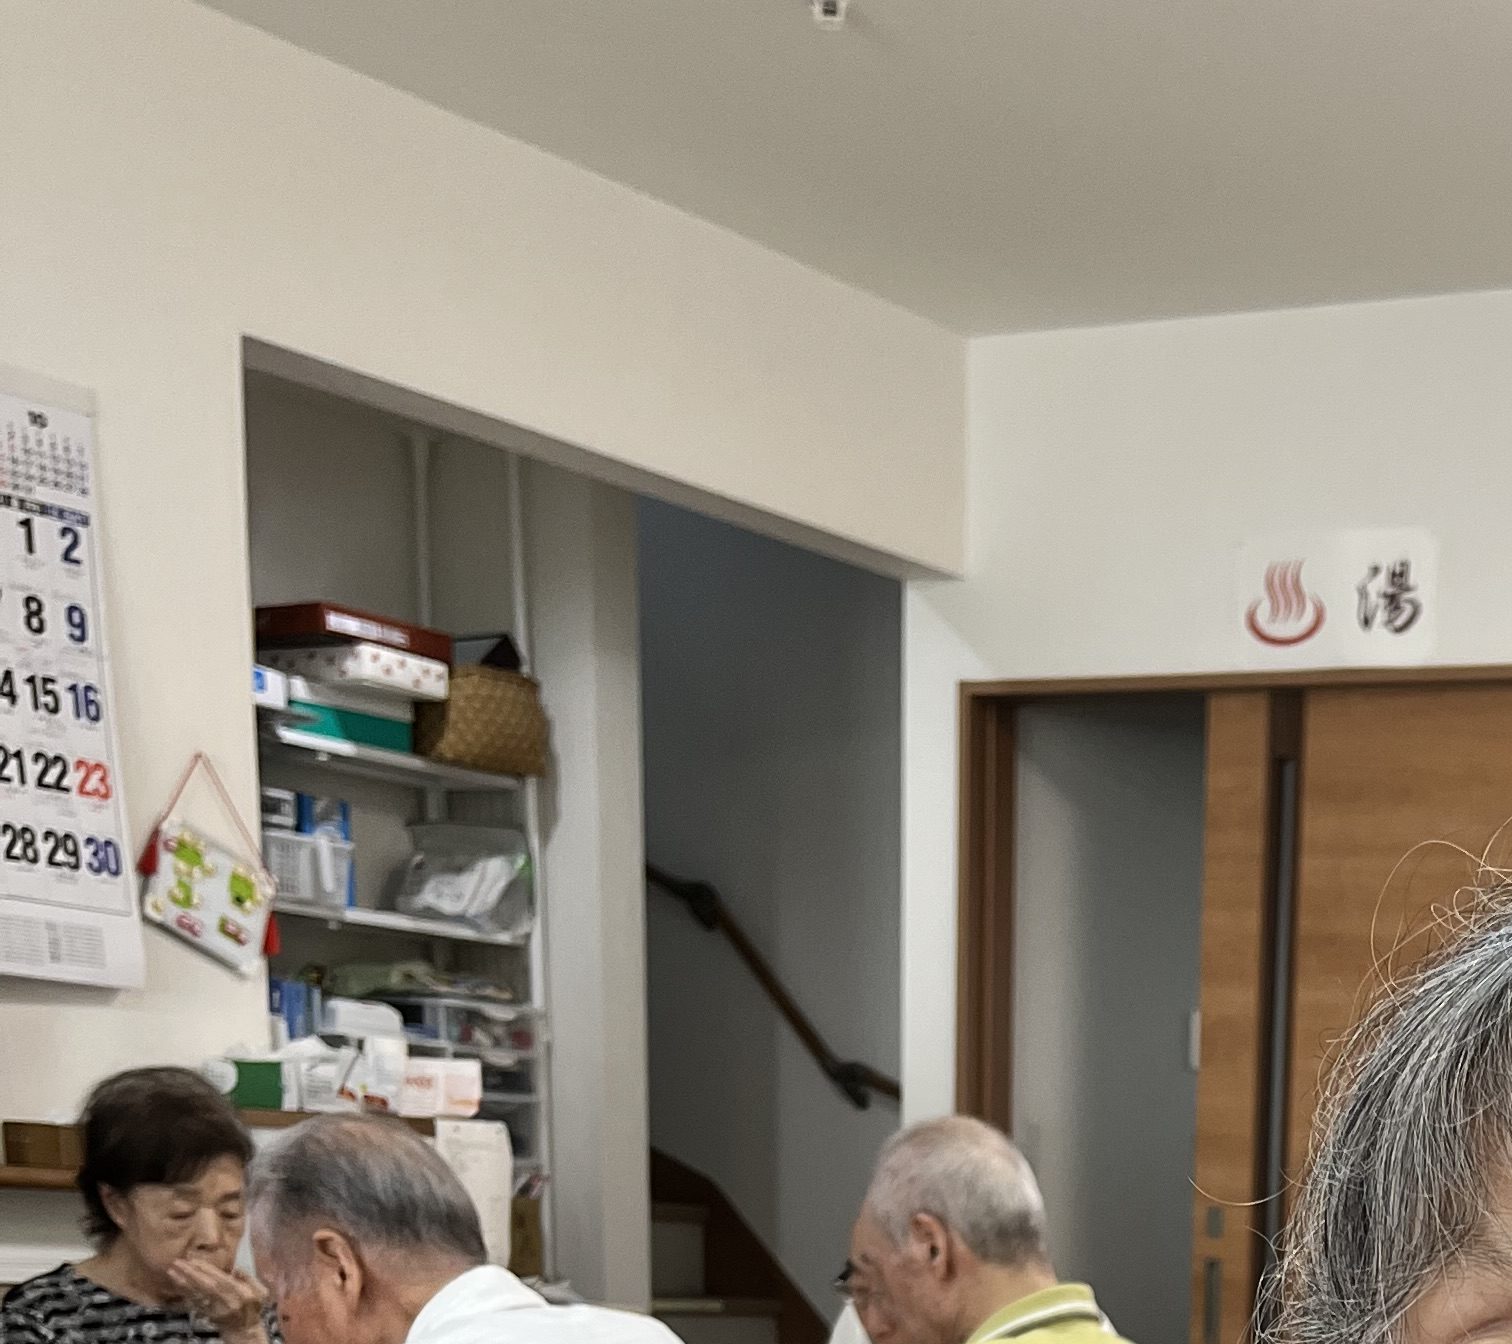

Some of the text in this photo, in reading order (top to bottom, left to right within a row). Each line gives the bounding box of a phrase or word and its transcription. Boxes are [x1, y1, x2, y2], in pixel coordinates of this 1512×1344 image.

[17, 517, 82, 565] 1 2
[24, 595, 87, 643] 8 9
[0, 668, 101, 723] 4 15 16
[31, 751, 71, 793] 22
[74, 759, 111, 800] 23
[1, 823, 121, 877] 28 29 30
